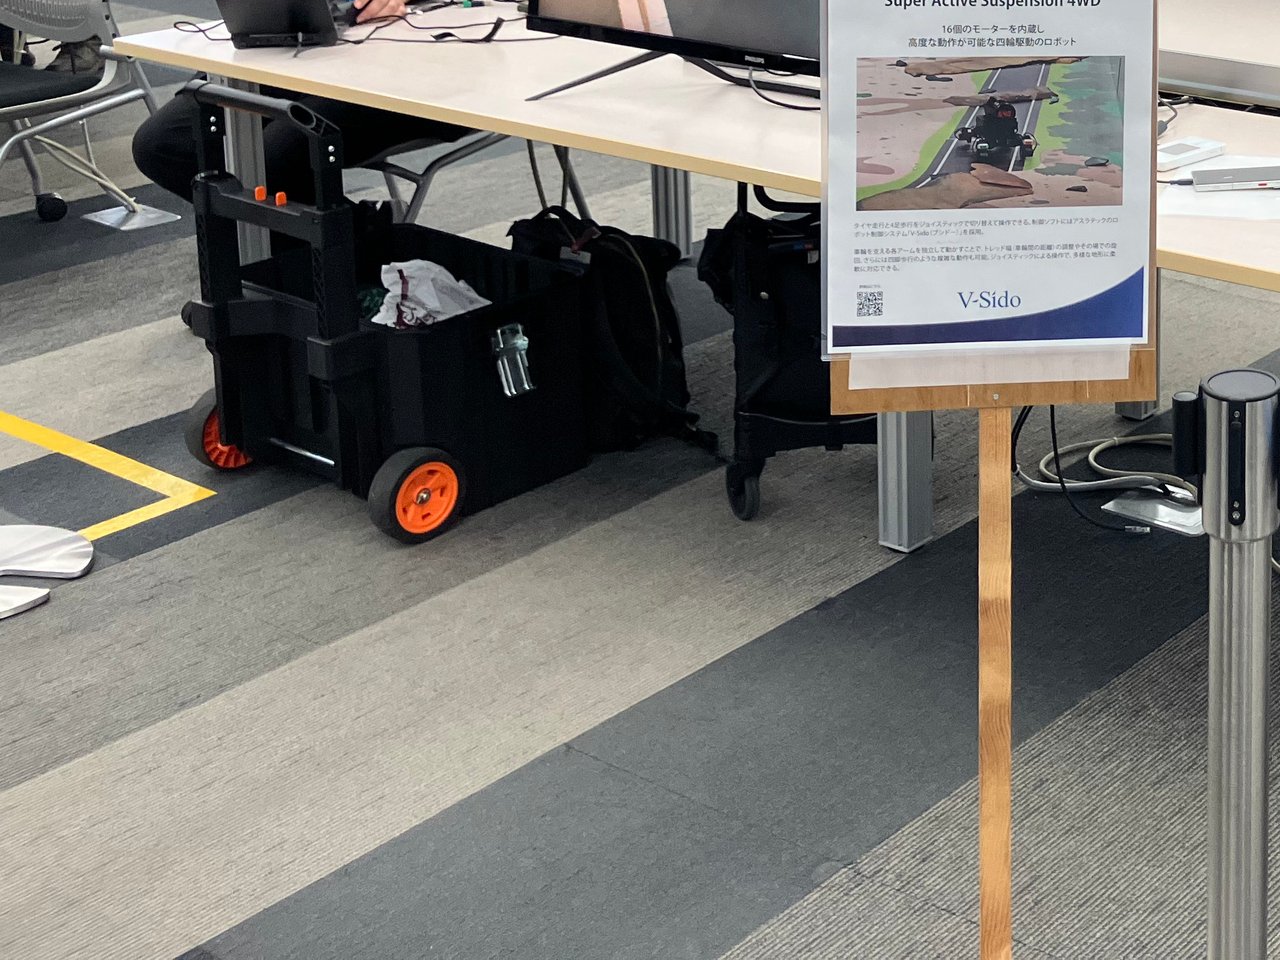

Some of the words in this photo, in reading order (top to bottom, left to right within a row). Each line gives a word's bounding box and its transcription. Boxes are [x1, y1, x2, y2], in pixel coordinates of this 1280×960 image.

[942, 24, 1045, 35] 16個のモーターを内蔵し
[908, 36, 1077, 48] 高度な動作が可能な四輪駆動のロボット
